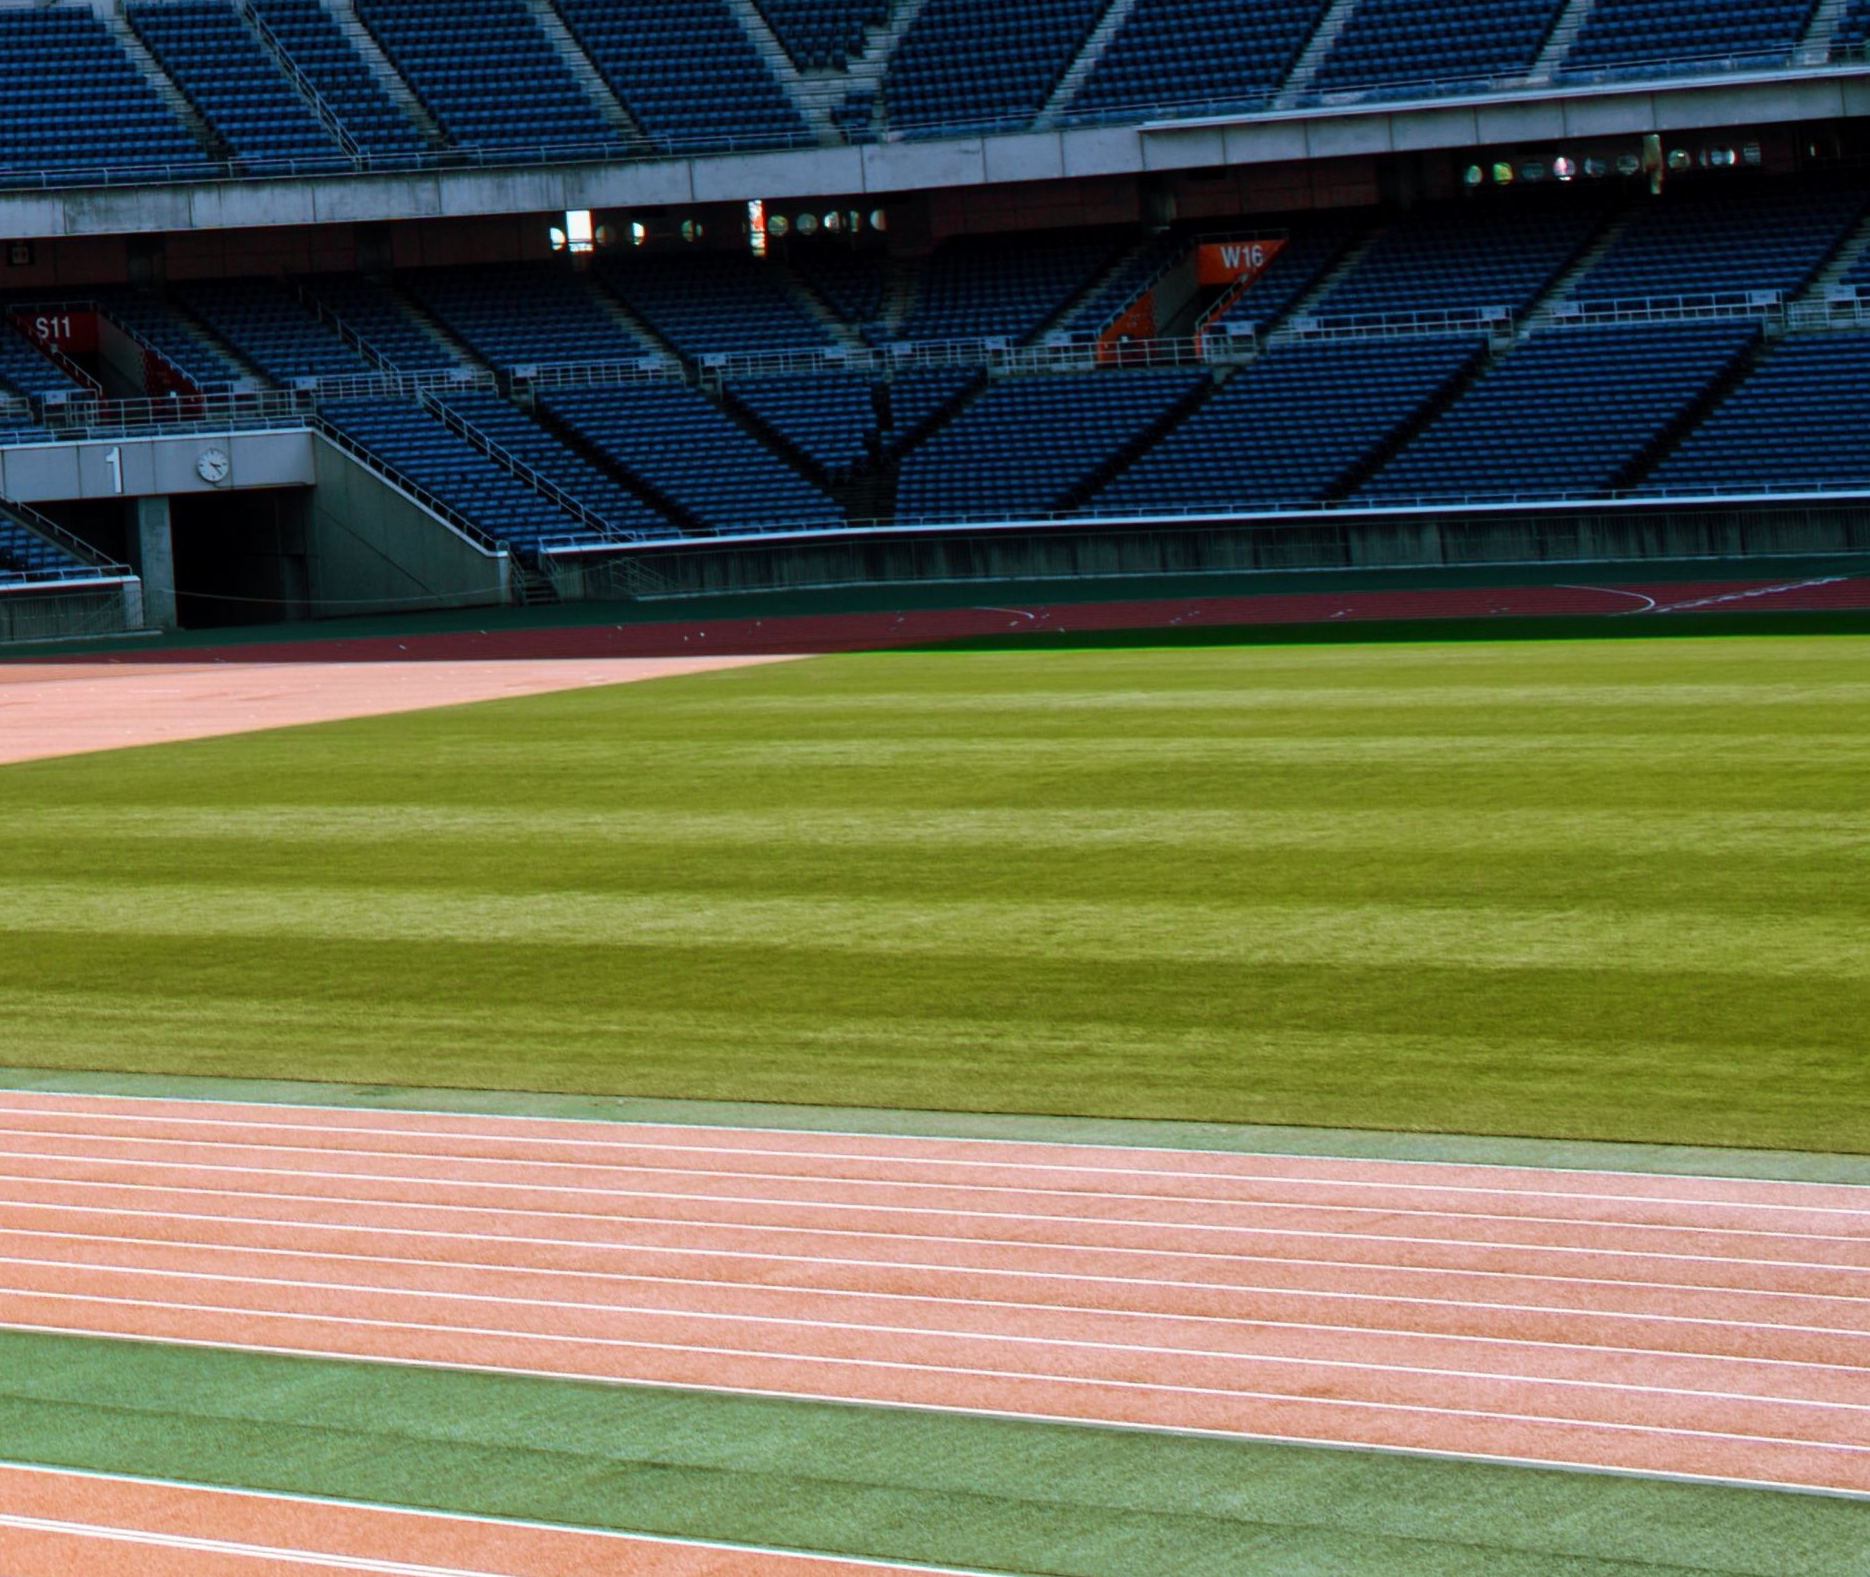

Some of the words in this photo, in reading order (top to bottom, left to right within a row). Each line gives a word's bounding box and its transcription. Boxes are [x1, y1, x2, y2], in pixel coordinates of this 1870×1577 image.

[1221, 244, 1263, 269] W16
[35, 315, 71, 339] S11
[105, 446, 124, 494] 1
